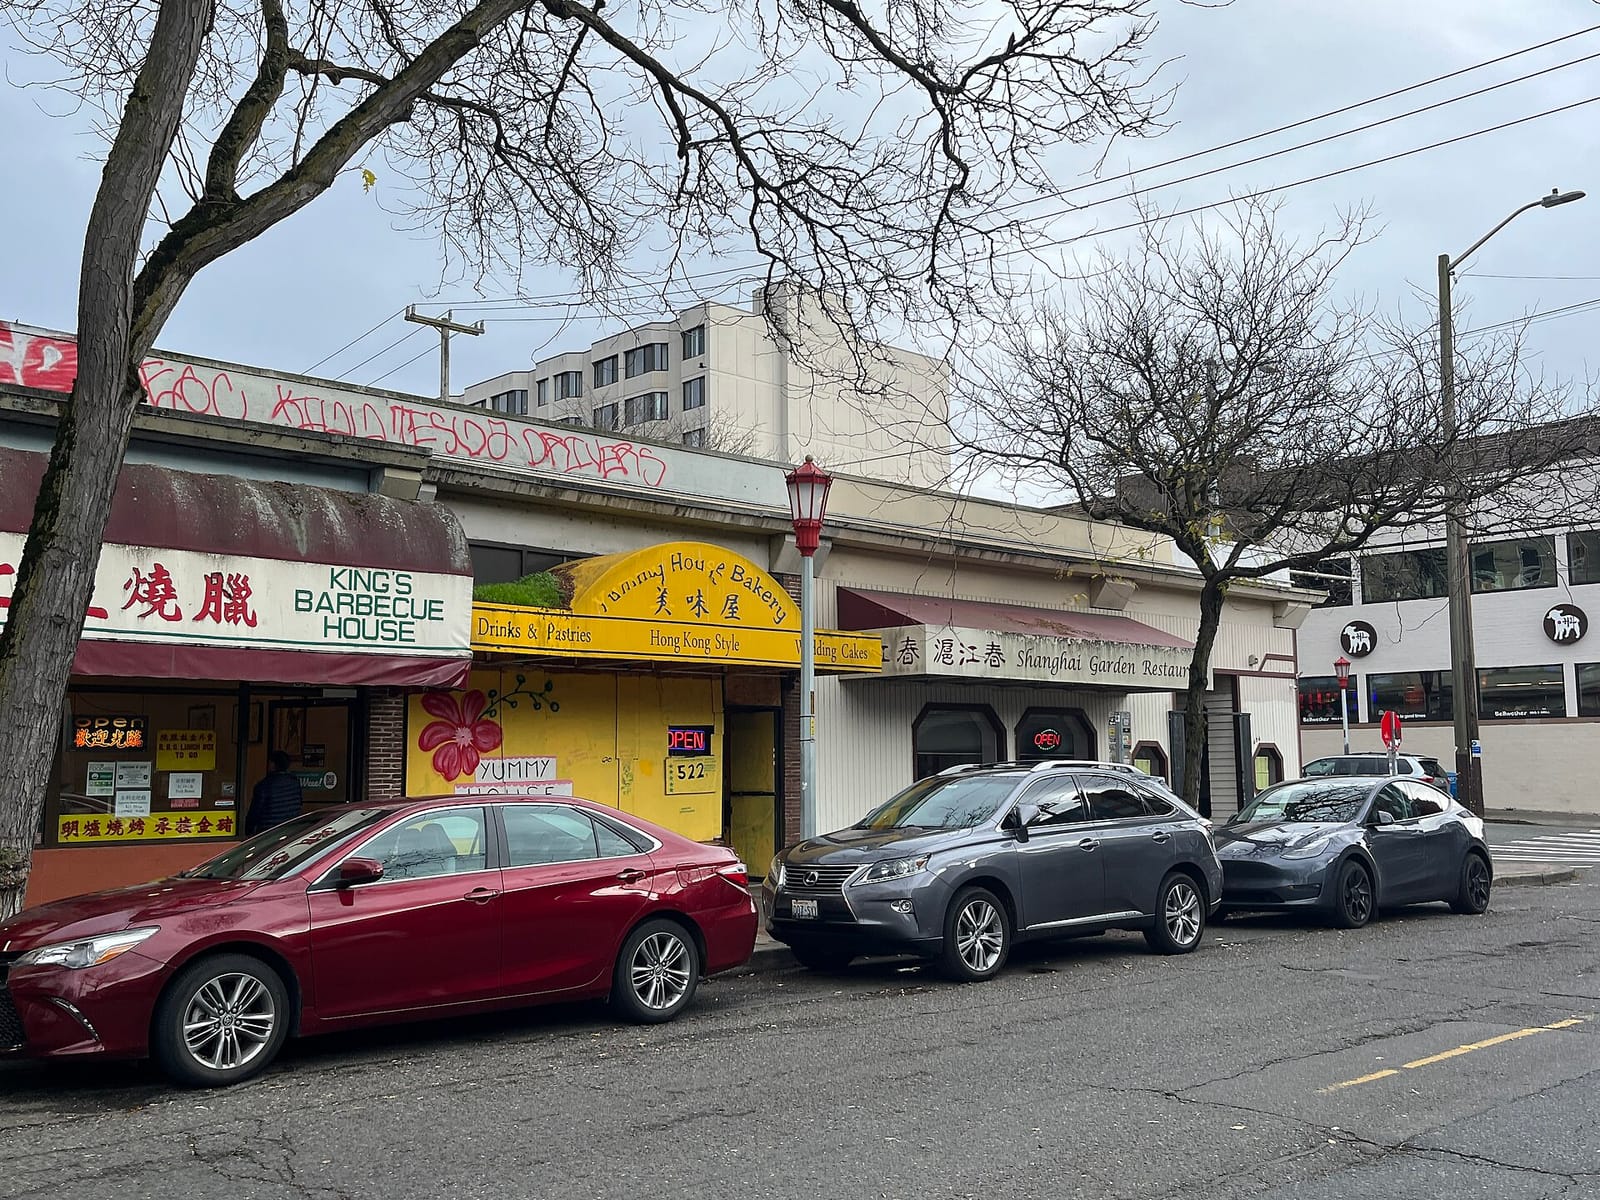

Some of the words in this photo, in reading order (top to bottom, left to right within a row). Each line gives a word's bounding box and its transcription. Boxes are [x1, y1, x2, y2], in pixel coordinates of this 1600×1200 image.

[330, 567, 412, 595] KING'S
[731, 564, 787, 625] Bakery
[86, 562, 258, 628] 燒臘
[294, 589, 445, 621] BARBECUE
[654, 586, 741, 622] 美味屋
[323, 615, 415, 643] HOUSE
[478, 617, 521, 639] Drinks
[527, 623, 538, 640] &
[547, 622, 592, 643] Pastries
[650, 629, 680, 653] Hong
[683, 631, 711, 655] Kong
[715, 633, 740, 656] Style
[795, 639, 837, 662] Wding
[841, 643, 868, 660] Cakes
[1016, 649, 1081, 675] Shanghai
[1089, 655, 1135, 676] Garden
[1142, 659, 1190, 678] Restaur
[667, 731, 704, 749] OPEN
[1034, 733, 1060, 746] OPEN
[480, 758, 550, 781] YUMMY
[677, 762, 705, 780] 522
